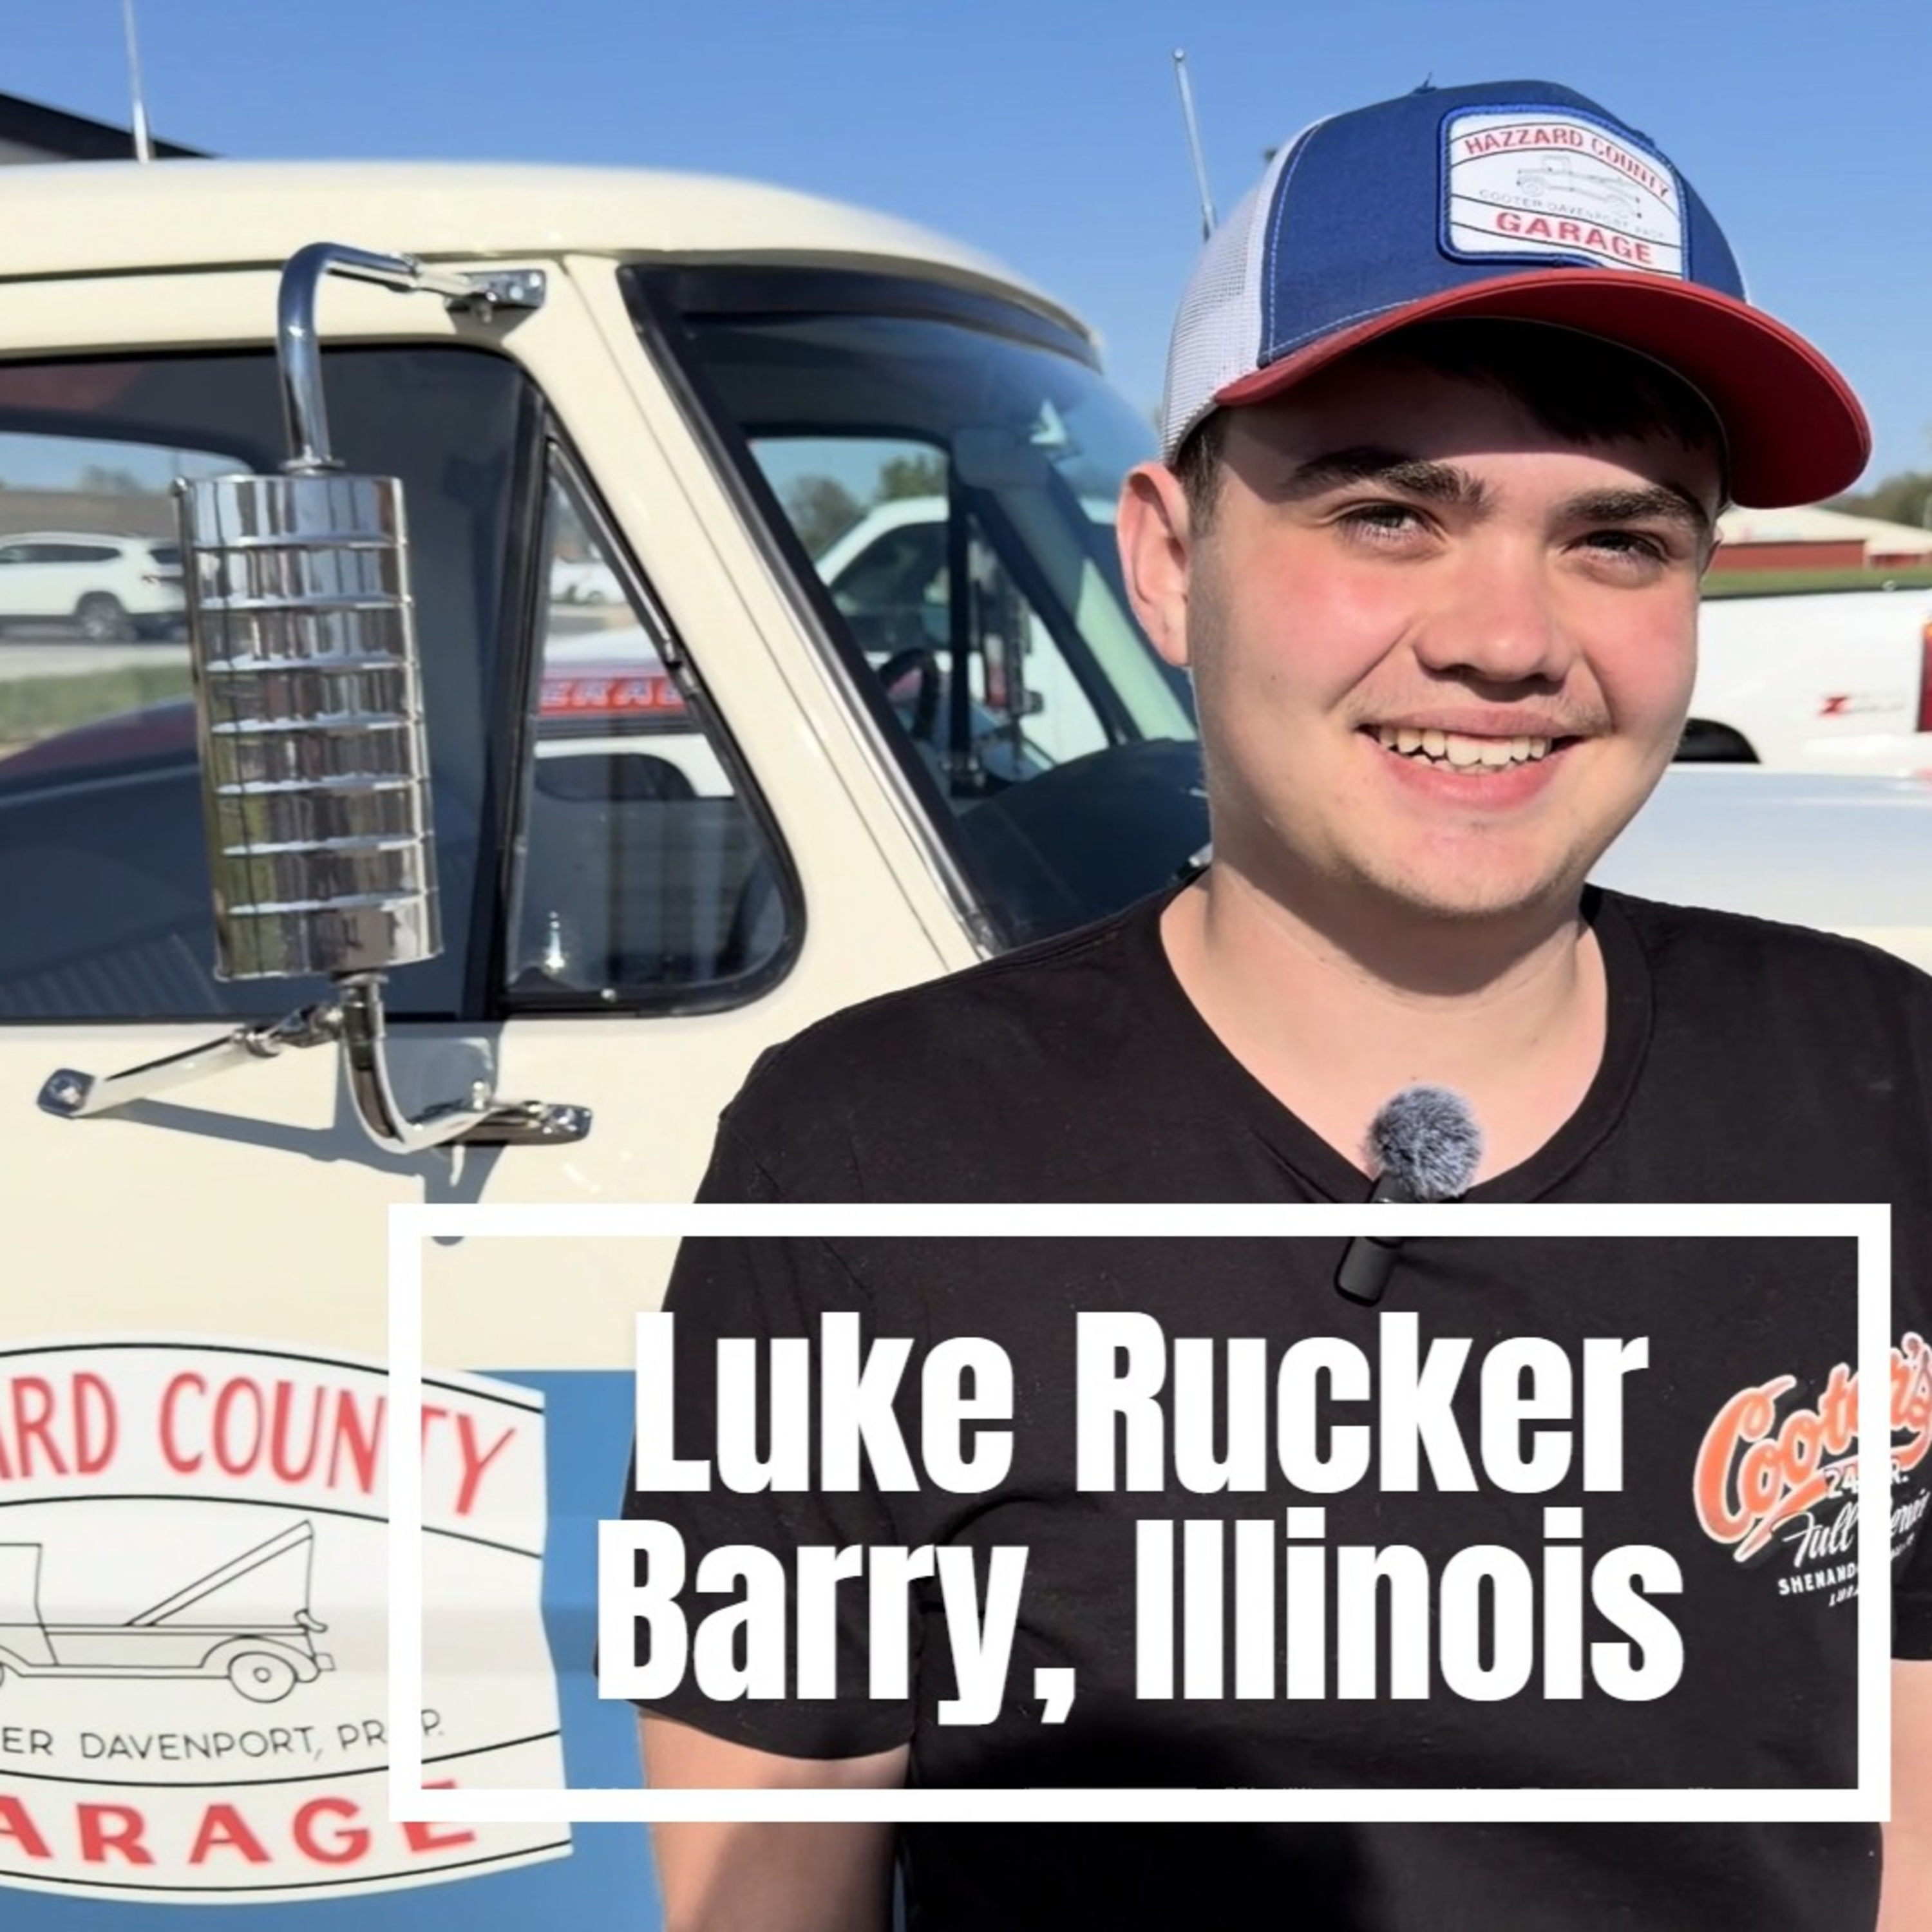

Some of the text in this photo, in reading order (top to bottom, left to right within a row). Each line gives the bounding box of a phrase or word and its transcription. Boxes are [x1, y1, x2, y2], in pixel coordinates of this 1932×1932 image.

[1465, 128, 1669, 197] HAZZARD COUNTY
[1479, 189, 1542, 207] COOTER
[1496, 211, 1654, 265] GARAGE
[1778, 1562, 1859, 1595] SHENAND
[80, 1725, 323, 1763] DAVENPORT,
[337, 1708, 445, 1751] PRP.
